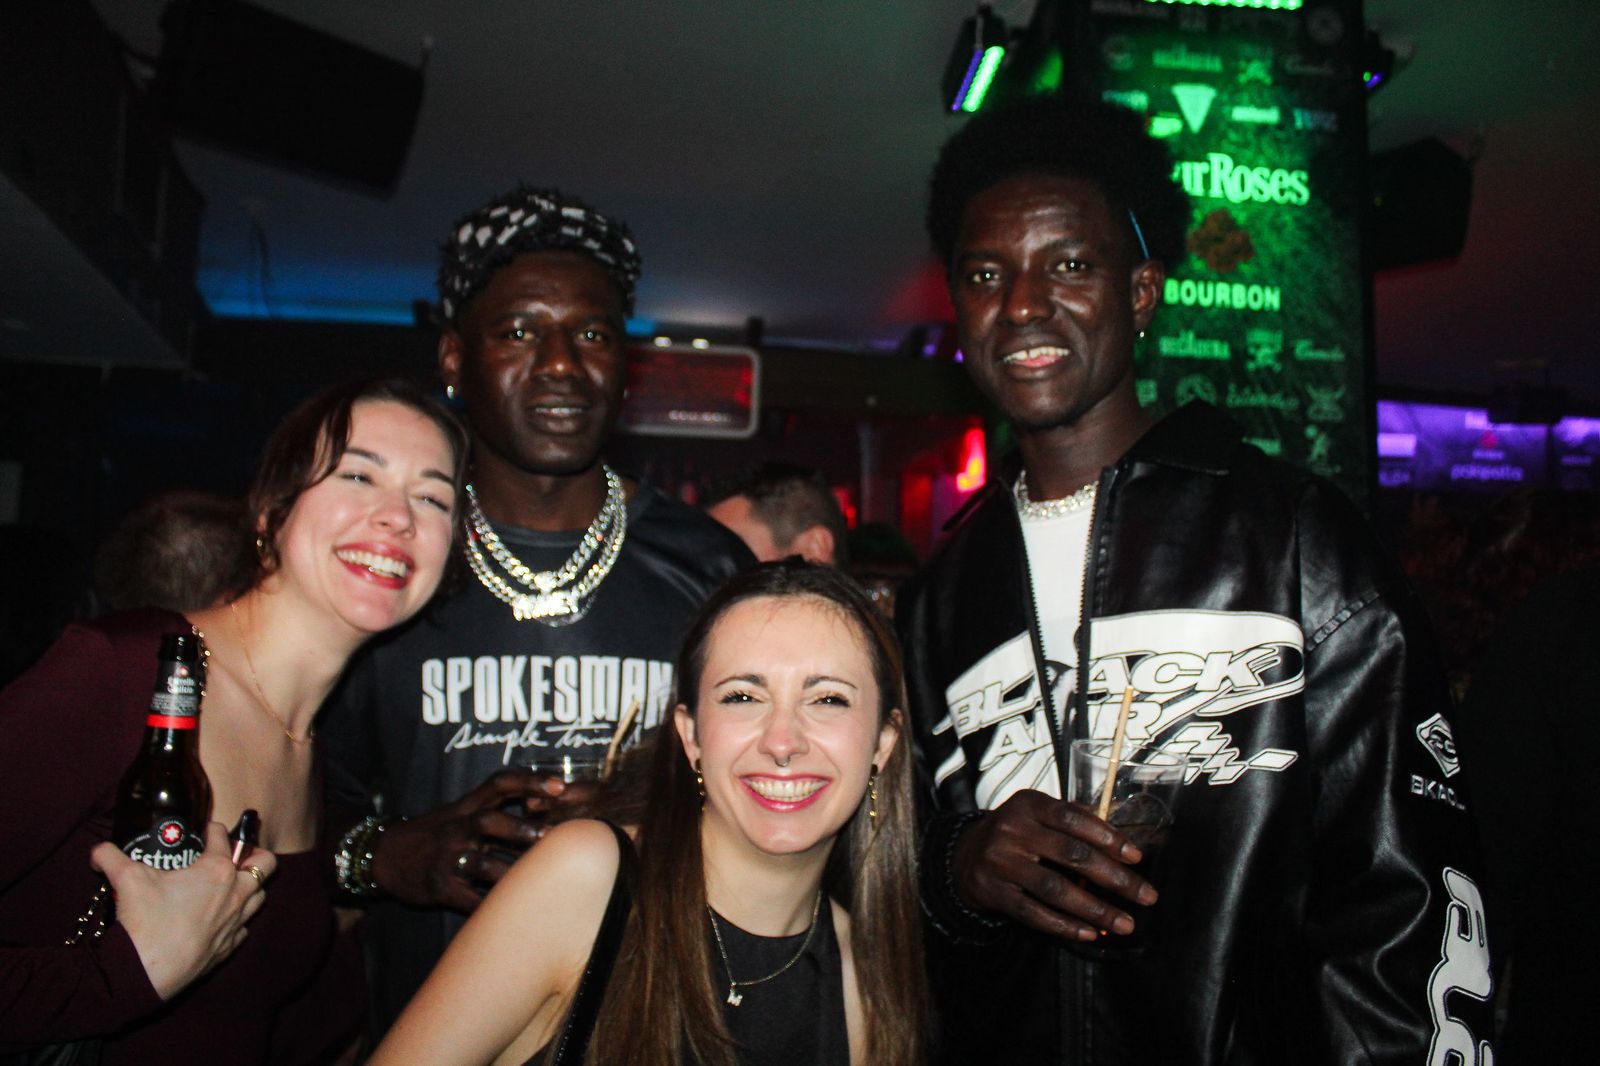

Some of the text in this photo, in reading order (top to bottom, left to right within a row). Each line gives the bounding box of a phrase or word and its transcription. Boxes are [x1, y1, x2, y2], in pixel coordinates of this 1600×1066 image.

[1207, 151, 1310, 206] Roses
[1163, 277, 1281, 312] BOURBON
[421, 654, 674, 730] SPOKESMAN
